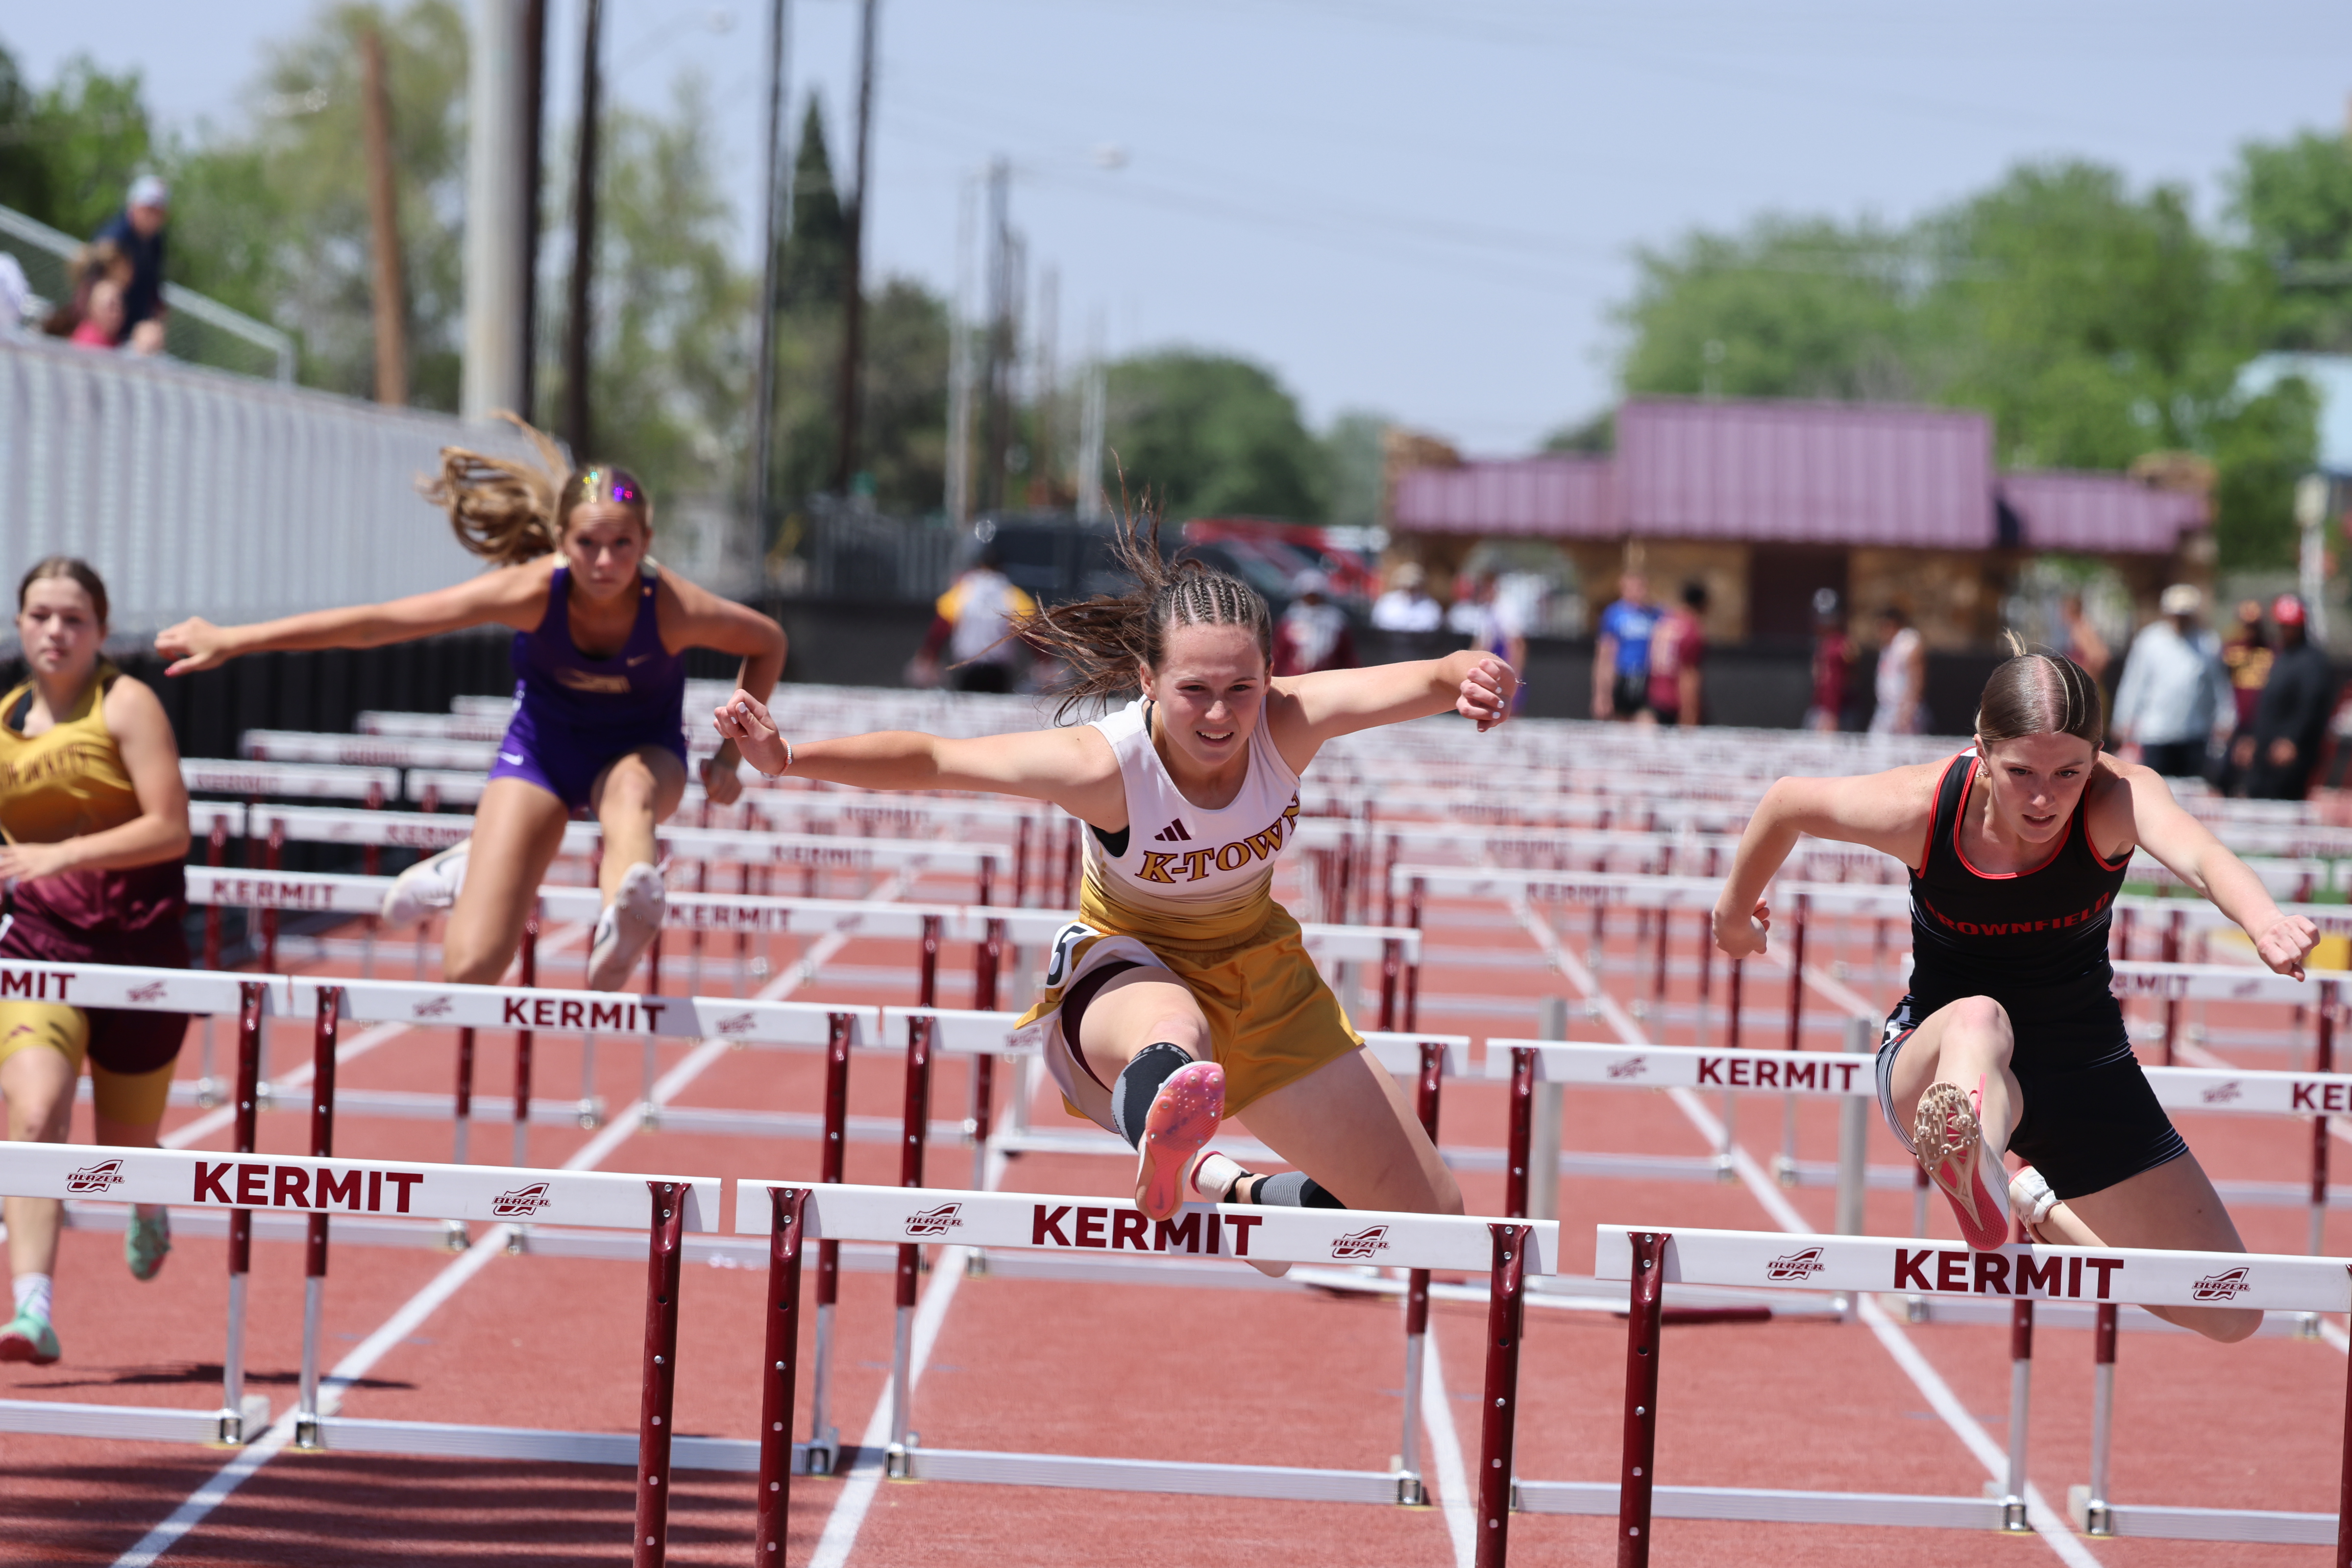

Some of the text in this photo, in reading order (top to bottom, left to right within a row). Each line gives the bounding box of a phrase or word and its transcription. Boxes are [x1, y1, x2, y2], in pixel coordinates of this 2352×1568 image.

[1135, 791, 1300, 883] K-TOWN
[213, 879, 337, 908] KERMIT
[0, 970, 75, 999] MIT
[2112, 974, 2192, 995] RMIT
[504, 998, 665, 1032] KERMIT
[1697, 1057, 1861, 1091] KERMIT
[67, 1174, 123, 1184] BLAZER
[194, 1162, 423, 1213] KERMIT
[493, 1196, 550, 1206] BLAZER
[906, 1217, 962, 1227] BLAZER
[1032, 1204, 1262, 1256] KERMIT
[1332, 1240, 1389, 1249] BLAZER
[1767, 1262, 1824, 1272] BLAZER
[1894, 1249, 2124, 1299] KERMIT
[2194, 1281, 2249, 1291] BLAZER
